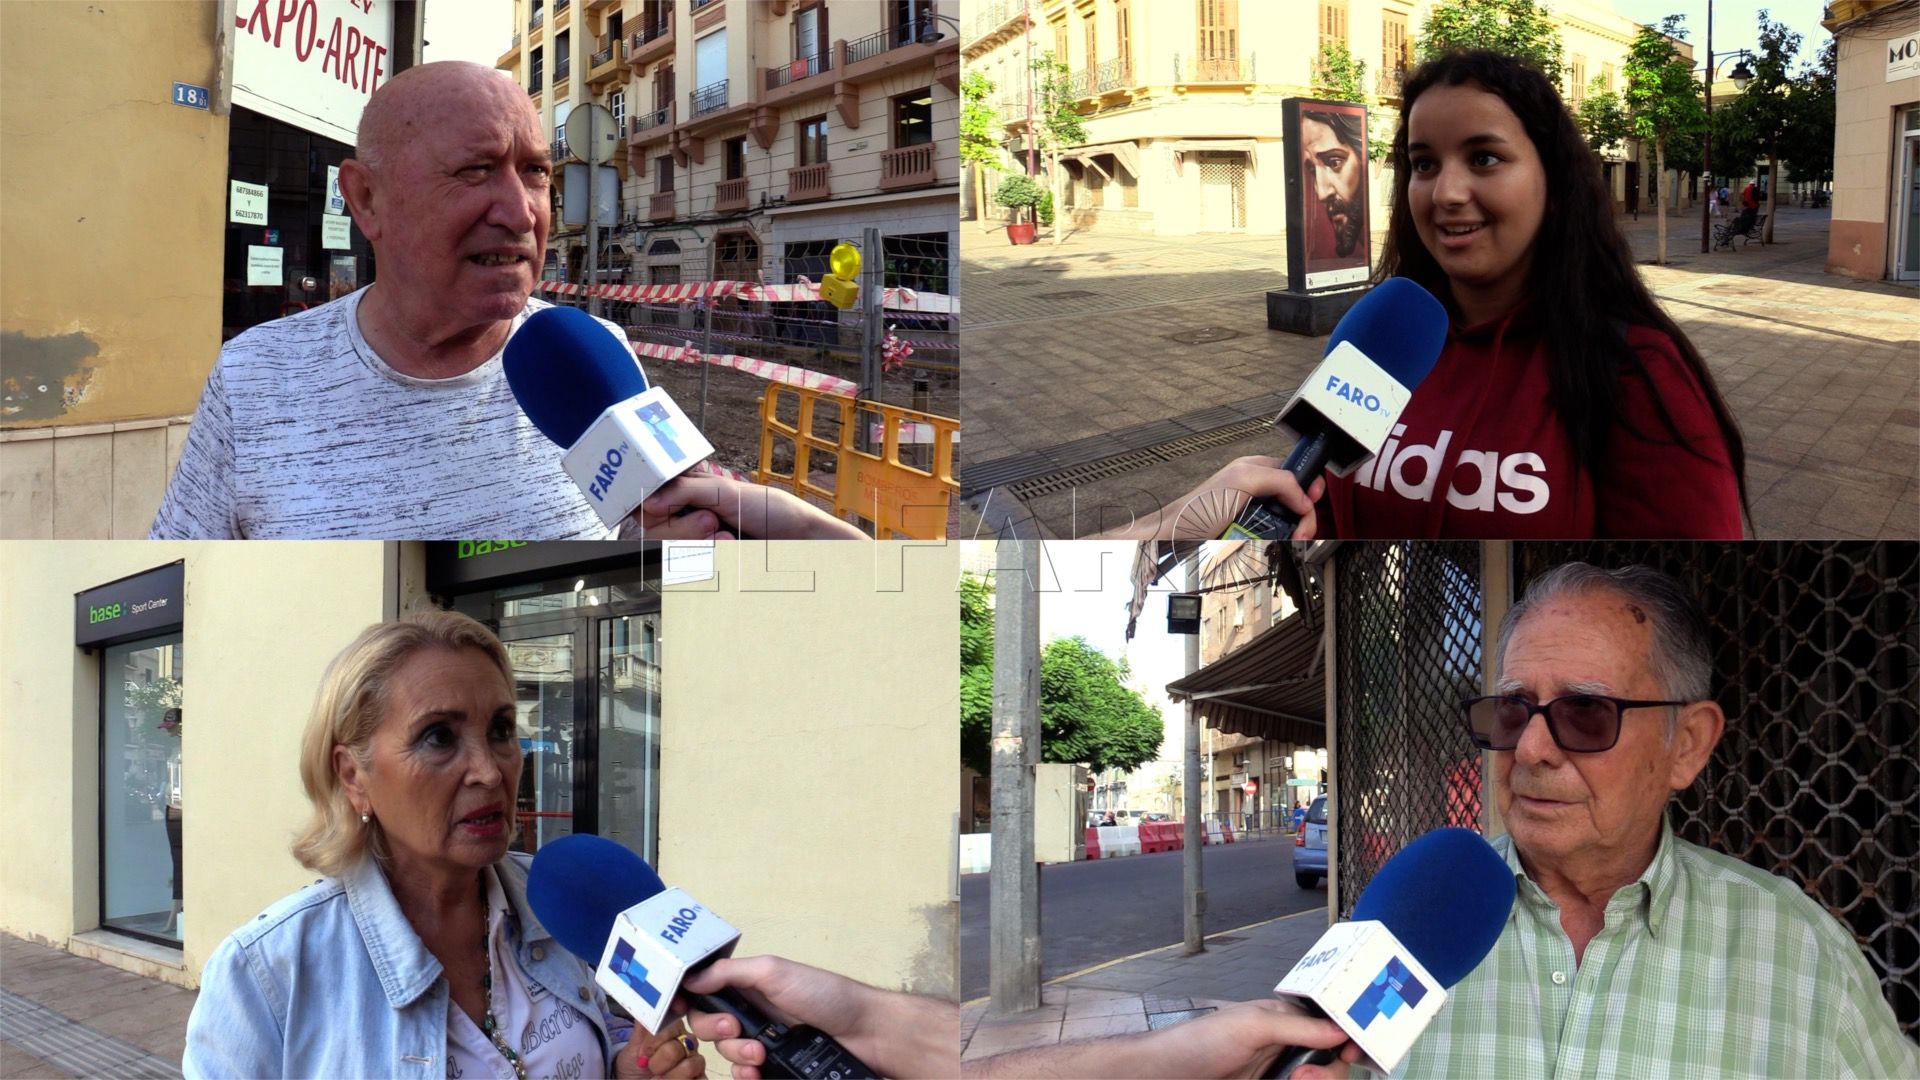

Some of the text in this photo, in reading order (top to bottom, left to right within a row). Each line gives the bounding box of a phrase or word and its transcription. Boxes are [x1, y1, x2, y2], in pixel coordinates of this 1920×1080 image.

[235, 0, 387, 97] XPO-ARTE
[1890, 37, 1920, 64] MO
[177, 87, 197, 104] 18
[1326, 375, 1380, 411] FARO
[589, 448, 623, 502] FARO
[1354, 423, 1550, 515] idas
[132, 603, 147, 614] Sport
[148, 598, 168, 610] Center
[660, 908, 697, 944] FARO
[1295, 947, 1338, 971] FARO
